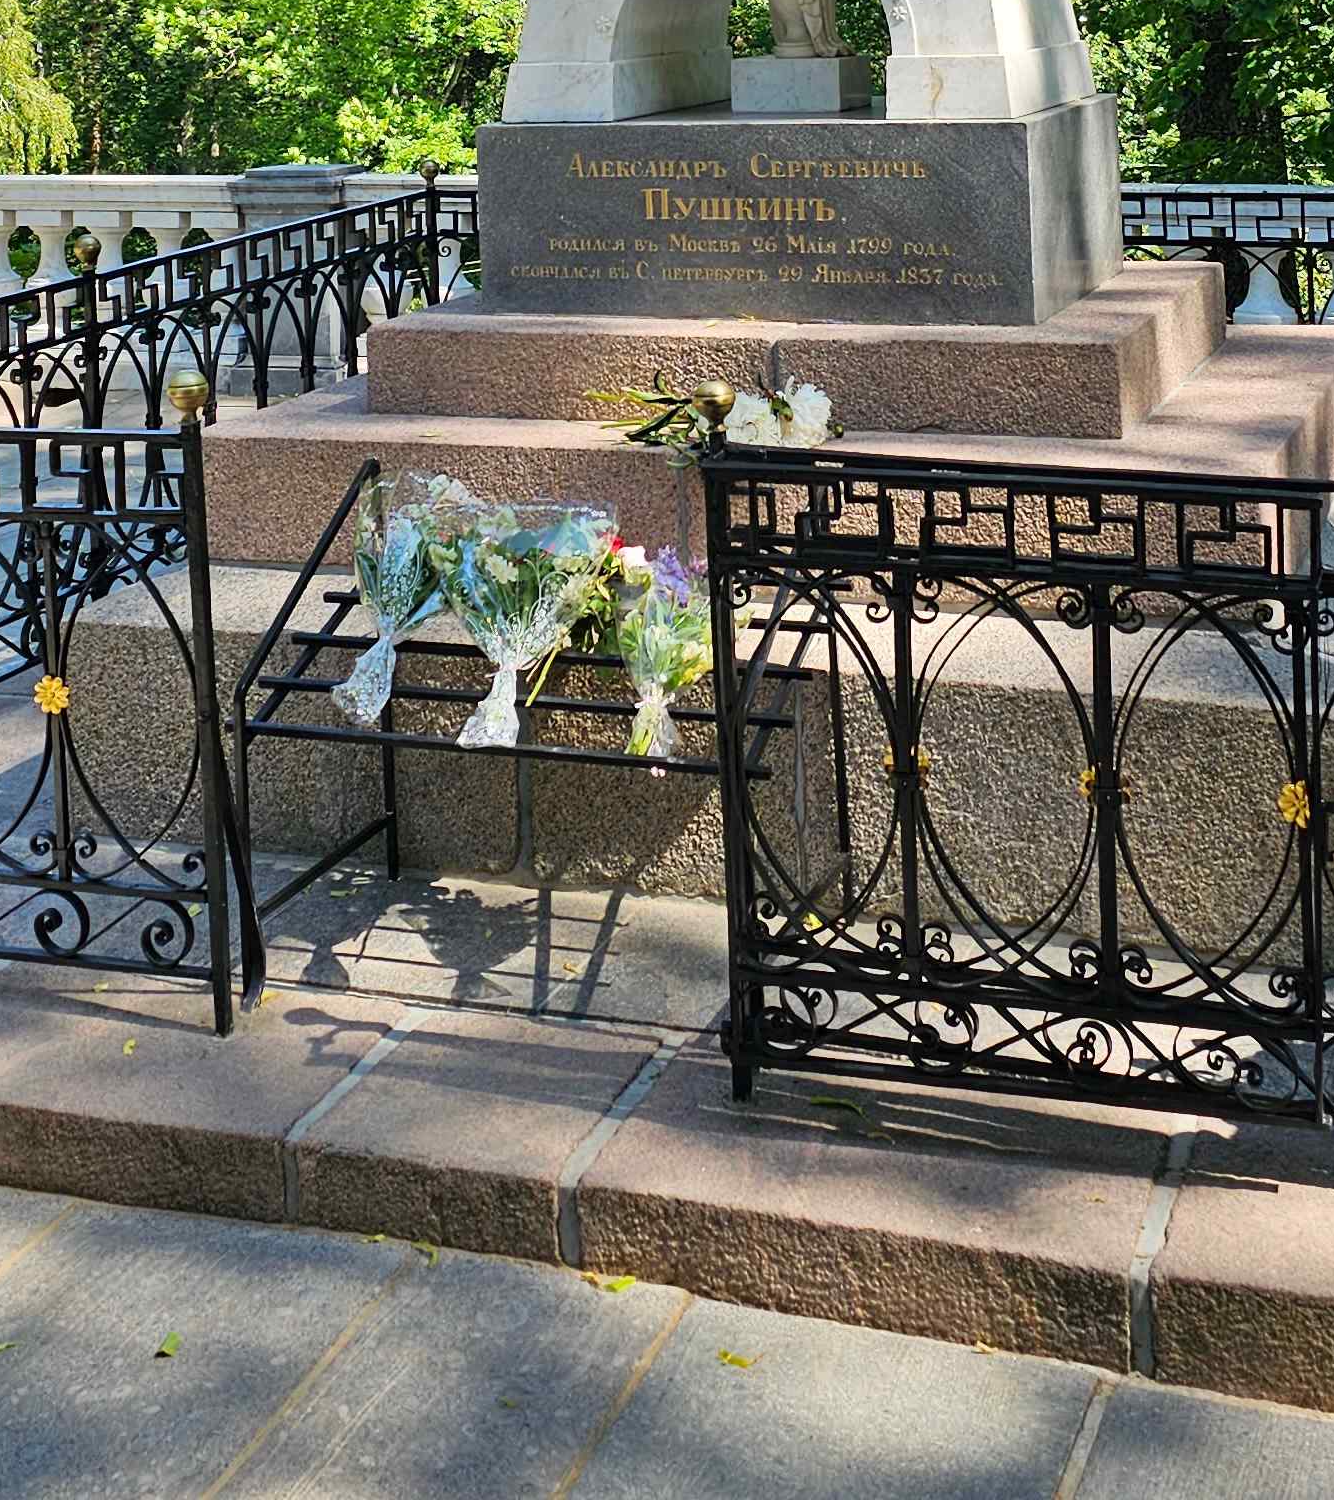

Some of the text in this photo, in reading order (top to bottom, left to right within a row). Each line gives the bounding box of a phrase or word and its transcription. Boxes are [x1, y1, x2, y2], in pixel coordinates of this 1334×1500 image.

[752, 235, 779, 253] 26
[845, 237, 893, 256] 1799
[777, 264, 804, 283] 29
[895, 266, 944, 286] 1837
